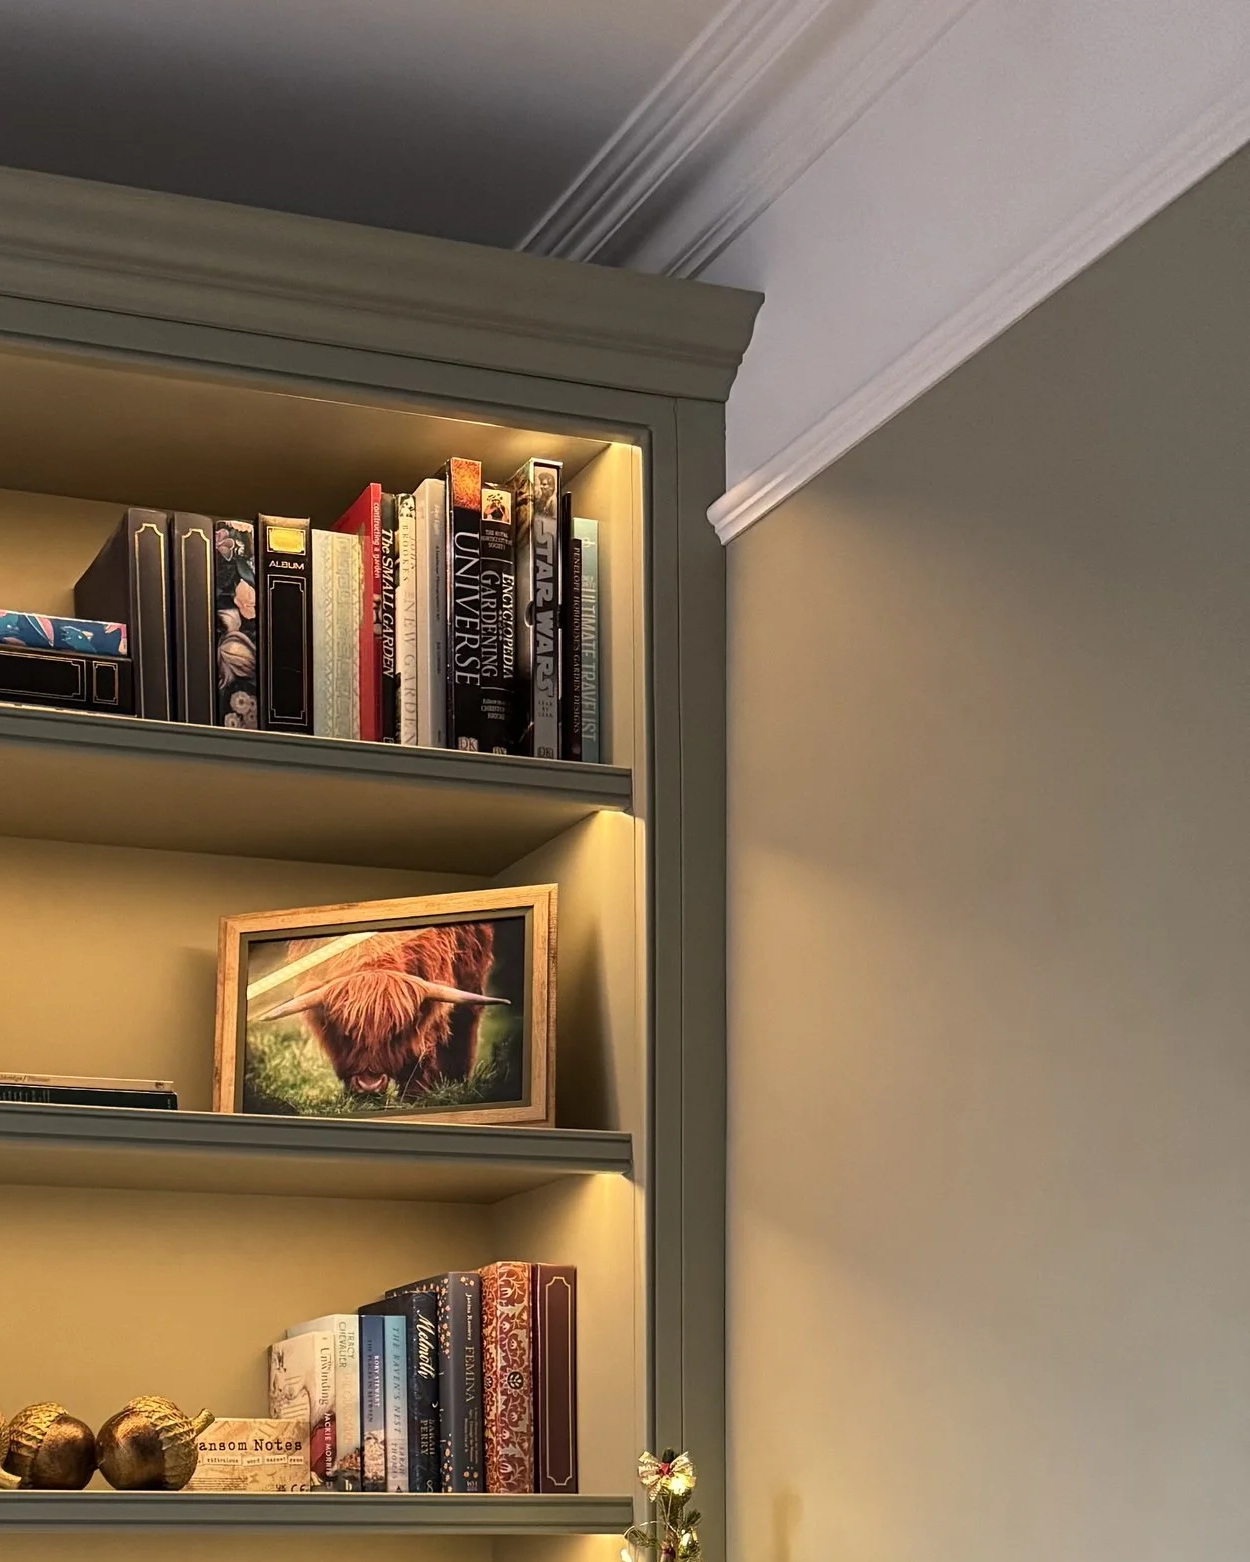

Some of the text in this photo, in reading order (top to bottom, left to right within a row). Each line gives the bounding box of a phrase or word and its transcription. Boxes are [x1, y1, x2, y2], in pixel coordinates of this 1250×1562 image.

[373, 502, 381, 545] constructing
[269, 560, 305, 571] ALBUM
[372, 553, 381, 579] garden
[402, 524, 410, 581] BROOKES
[382, 528, 395, 678] The SMALL GARDEN
[404, 600, 416, 643] NEW
[454, 531, 481, 686] UNIVERSE
[480, 570, 500, 677] GARDENING
[502, 572, 515, 679] ENCYCLOPEDIA
[534, 520, 554, 697] STAR WARS
[404, 654, 417, 746] GARDEN
[573, 695, 581, 733] DESIGNS
[338, 1321, 347, 1369] CHEVALIER
[347, 1331, 355, 1360] TRACY
[416, 1309, 436, 1380] Melmoth
[392, 1327, 402, 1433] THE RAVEN'S NEST
[465, 1346, 475, 1402] FEMINA
[198, 1438, 303, 1452] ansom Notes
[324, 1412, 333, 1476] JACKIE MORRIS
[420, 1419, 429, 1456] PERRY
